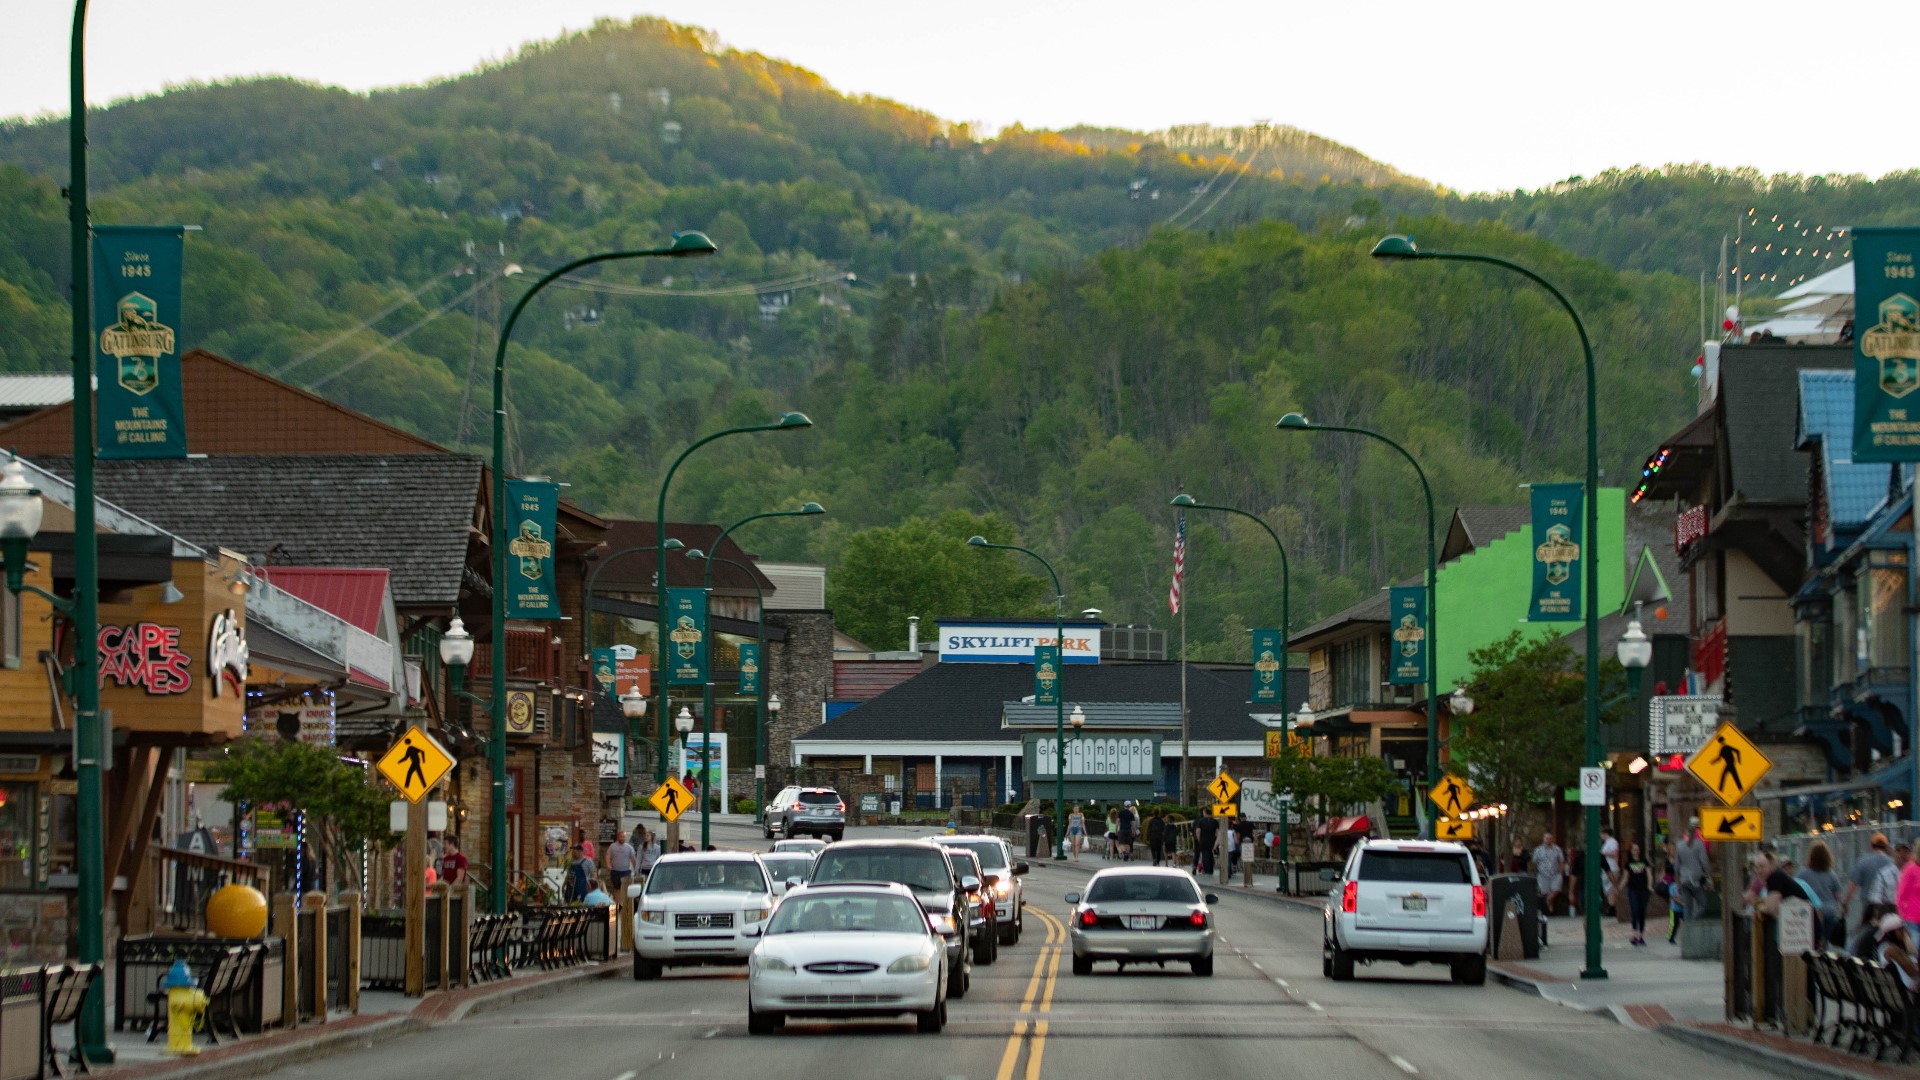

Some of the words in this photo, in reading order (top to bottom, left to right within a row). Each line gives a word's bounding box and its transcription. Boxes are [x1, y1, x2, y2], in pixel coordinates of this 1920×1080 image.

[121, 265, 152, 278] 1945
[1884, 265, 1916, 278] 1945
[101, 331, 175, 354] GATLINBURG
[131, 407, 149, 418] THE
[115, 419, 168, 431] MOUNTAINS
[128, 431, 167, 443] CALLING
[521, 503, 540, 511] 1945
[1549, 507, 1568, 516] 1945
[948, 635, 1034, 650] SKYLIFT
[1667, 704, 1696, 714] CHECK
